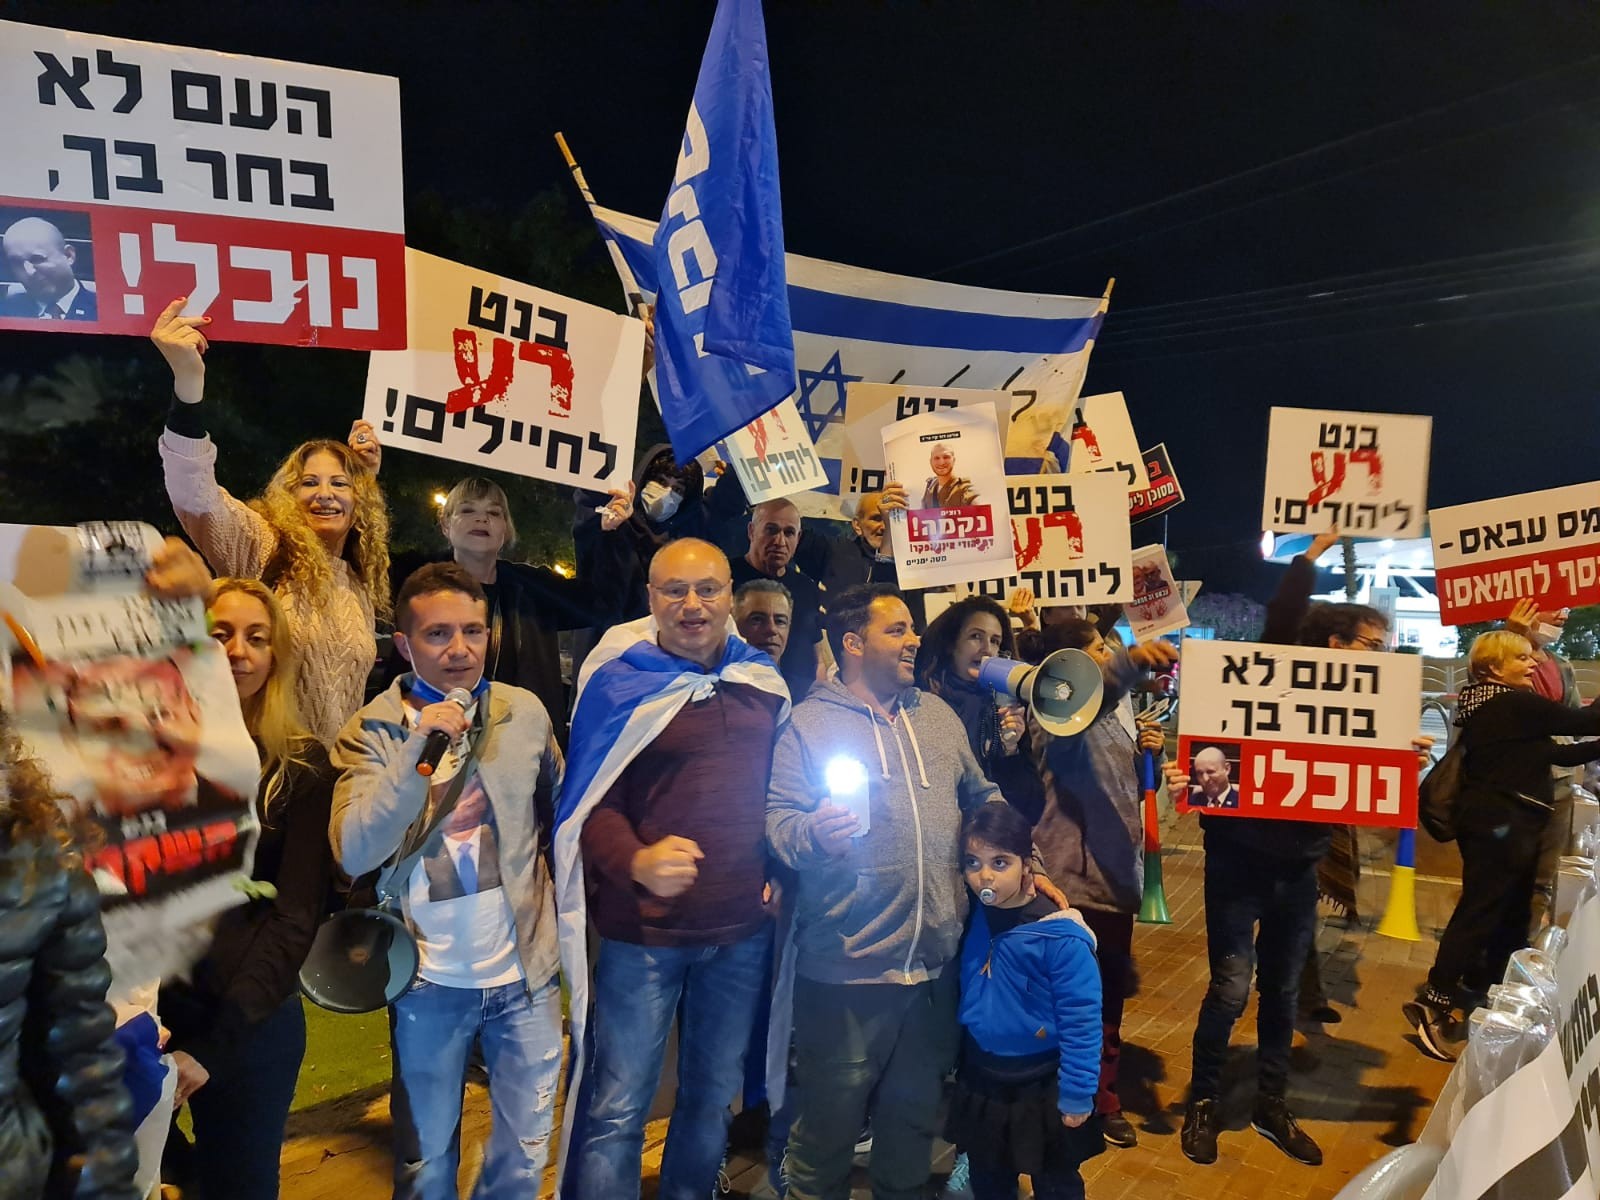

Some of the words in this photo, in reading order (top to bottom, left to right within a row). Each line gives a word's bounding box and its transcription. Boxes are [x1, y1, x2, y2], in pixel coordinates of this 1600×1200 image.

[34, 49, 142, 114] לא
[171, 69, 332, 138] העם
[48, 134, 164, 200] בך,
[186, 148, 334, 211] בחר
[119, 223, 379, 330] נוכל!
[467, 285, 568, 350] בנט
[445, 328, 574, 418] רע
[382, 388, 617, 480] לחיילים!
[1319, 422, 1378, 450] בנט
[740, 442, 818, 492] ליהודים!
[1307, 451, 1383, 506] רע
[1007, 486, 1075, 515] בנט
[1147, 482, 1174, 505] מסוכן
[1274, 497, 1414, 532] ליהודים!
[912, 516, 987, 538] נקמה!
[1011, 511, 1084, 571] רע
[1445, 560, 1550, 609] לחמאס!
[1558, 556, 1600, 596] סף
[1222, 652, 1275, 686] לא
[1291, 660, 1379, 694] העם
[1222, 700, 1281, 736] בך,
[1295, 704, 1377, 738] בחר
[1252, 749, 1401, 814] נוכל!
